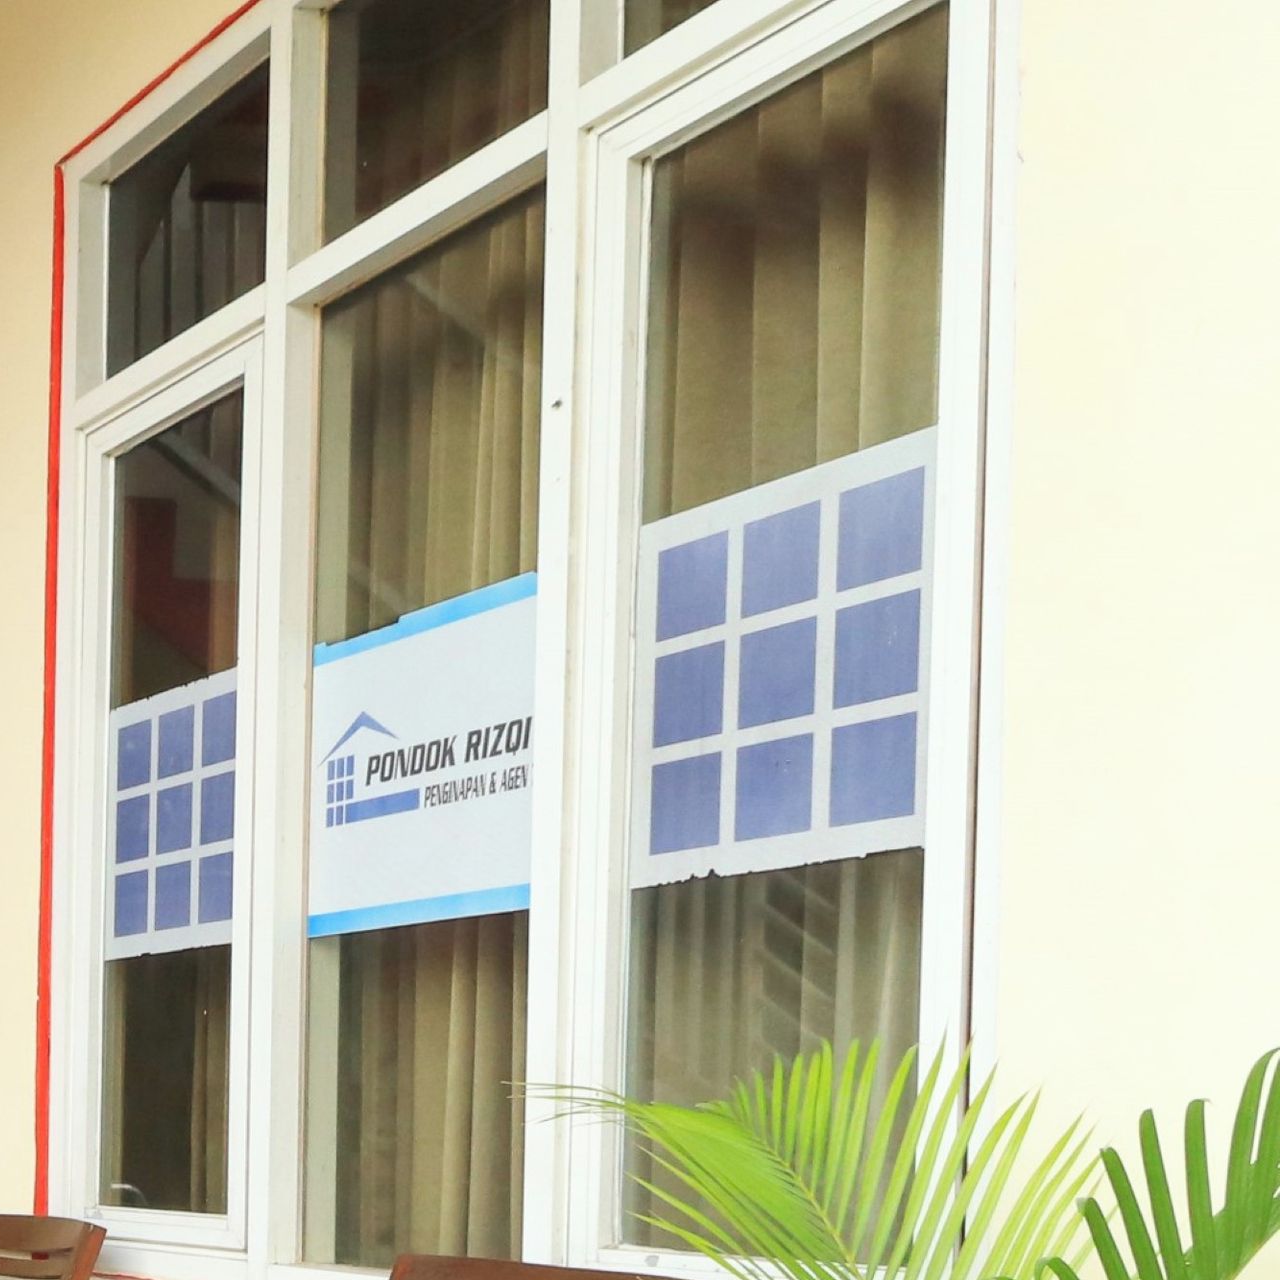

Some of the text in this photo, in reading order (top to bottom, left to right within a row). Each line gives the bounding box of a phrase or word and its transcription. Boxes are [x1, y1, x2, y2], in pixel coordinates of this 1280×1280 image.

[365, 716, 533, 787] PONDOK RIZQI
[424, 773, 488, 809] PENGINAPAN
[489, 772, 497, 794] &
[499, 764, 529, 792] AGEN
